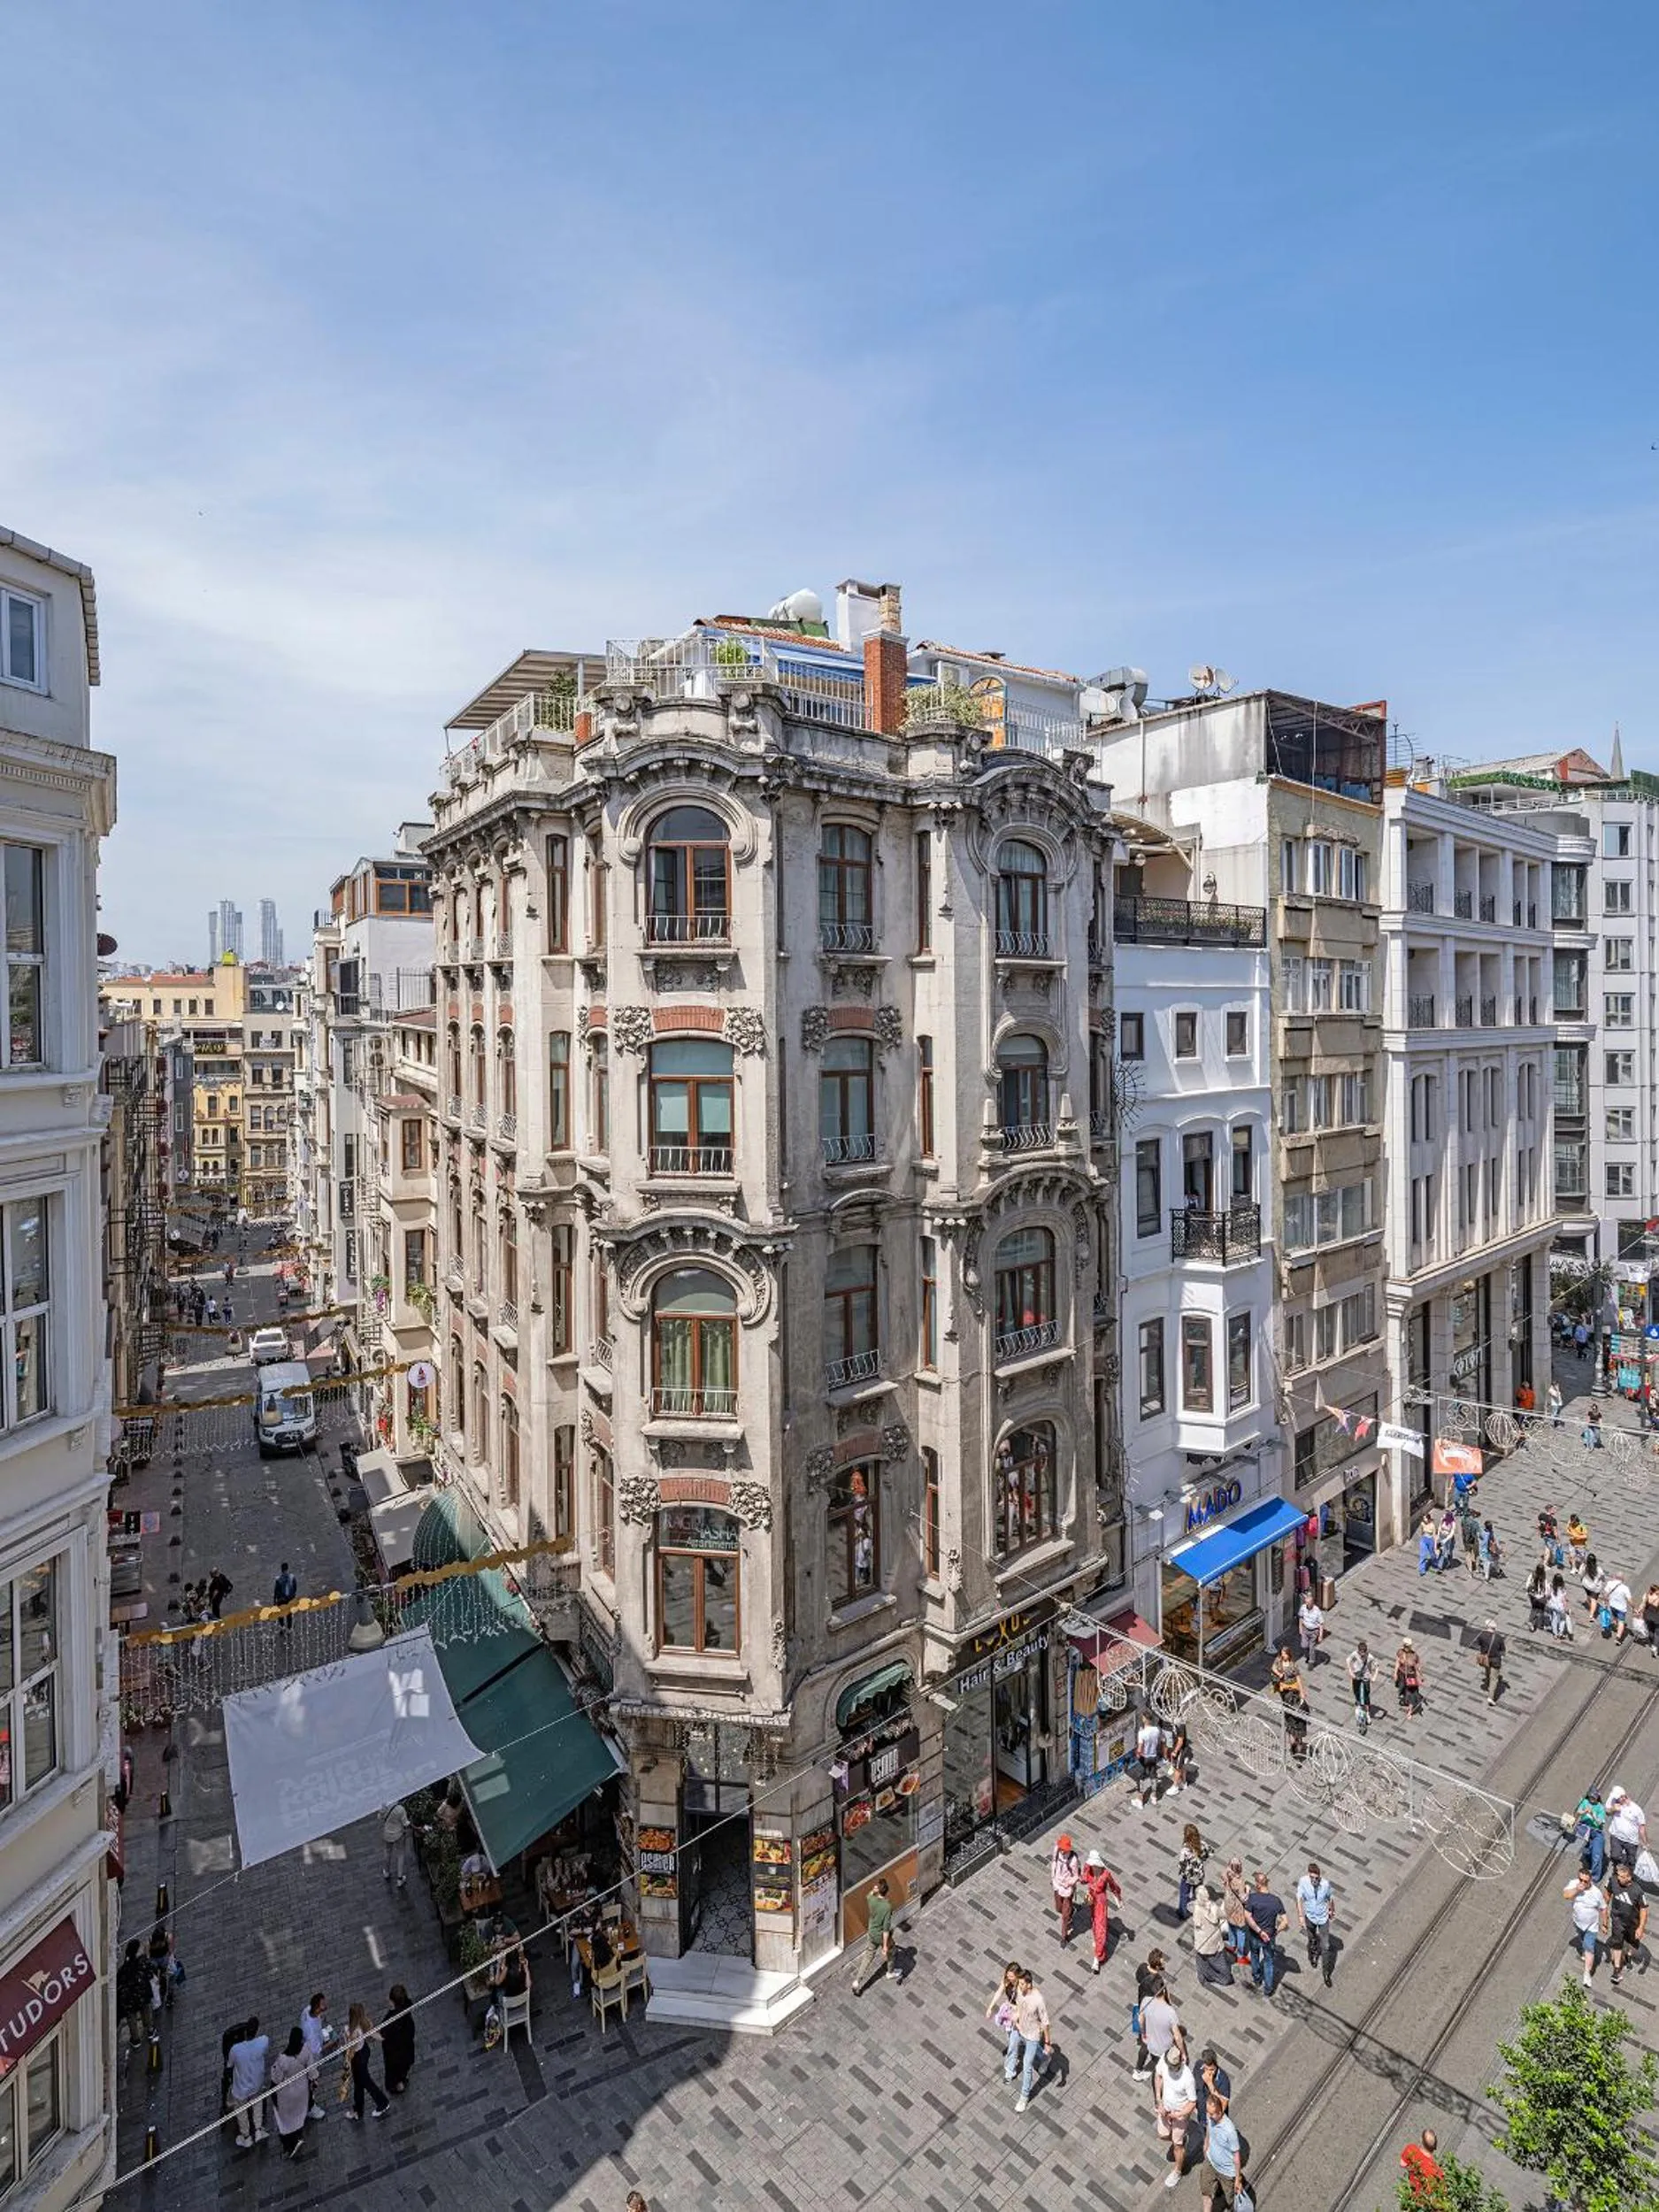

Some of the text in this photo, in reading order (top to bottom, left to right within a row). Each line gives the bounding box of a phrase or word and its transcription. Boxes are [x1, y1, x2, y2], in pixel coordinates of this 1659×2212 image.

[1187, 1480, 1241, 1530] MADO
[960, 1634, 1048, 1694] Hair & Beauty
[0, 1954, 88, 2053] TUDORS
